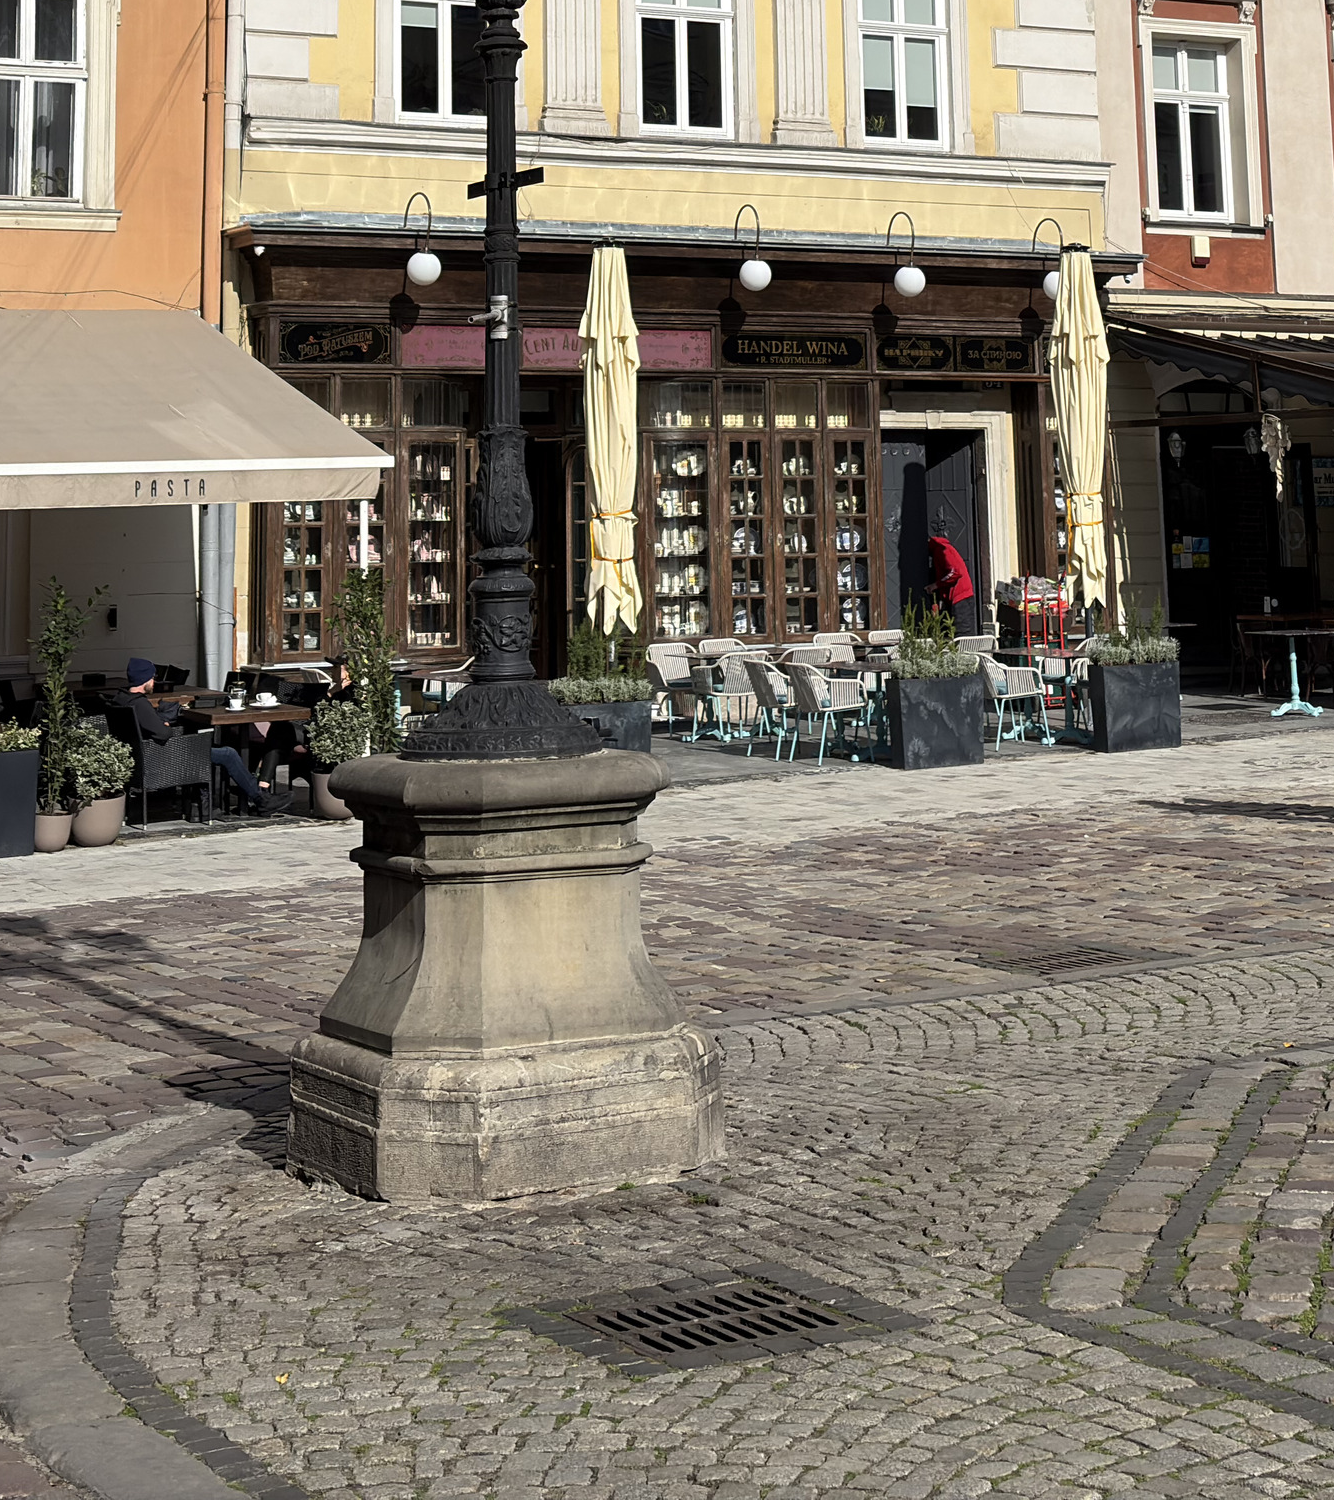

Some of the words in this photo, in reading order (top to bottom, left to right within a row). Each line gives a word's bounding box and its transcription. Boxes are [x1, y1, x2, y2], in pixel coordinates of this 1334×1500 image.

[737, 340, 802, 355] HANDEL
[806, 341, 848, 355] WINA
[967, 350, 980, 359] ЗА
[135, 478, 205, 498] PASTA
